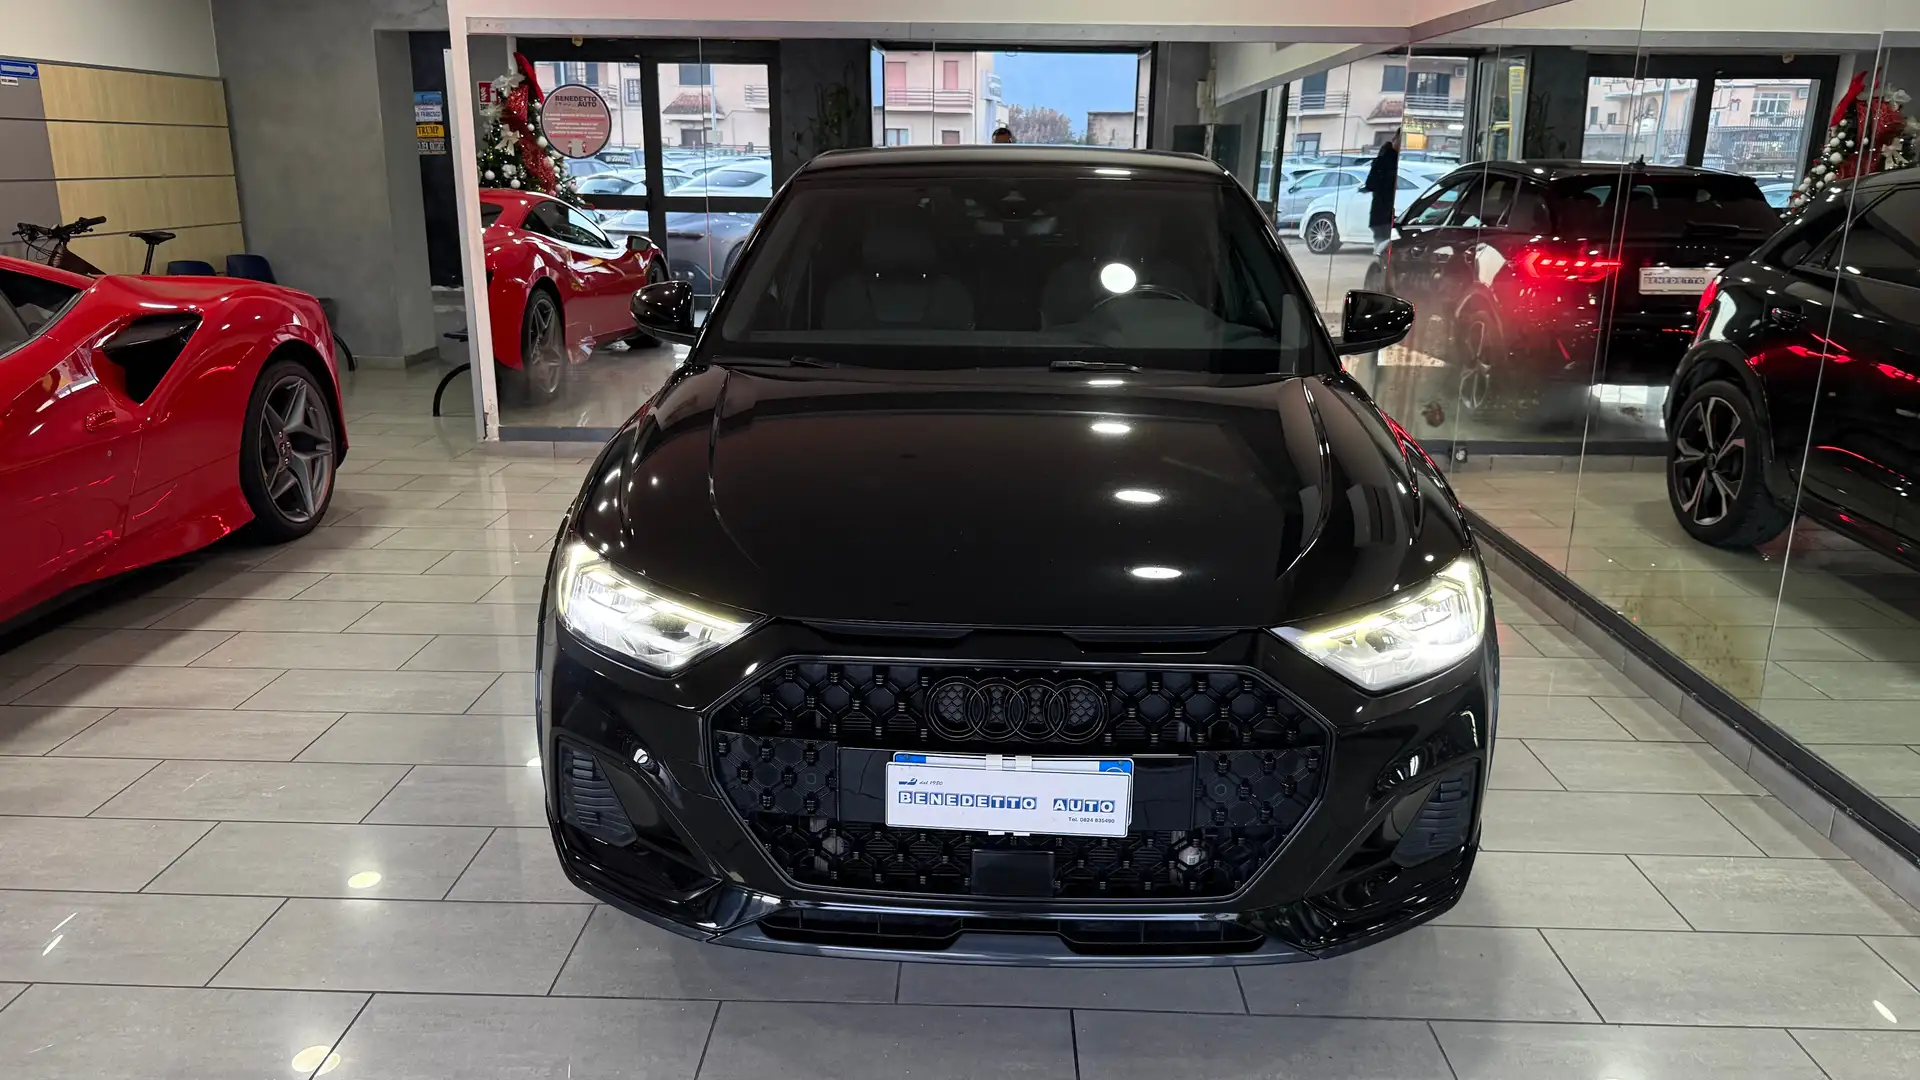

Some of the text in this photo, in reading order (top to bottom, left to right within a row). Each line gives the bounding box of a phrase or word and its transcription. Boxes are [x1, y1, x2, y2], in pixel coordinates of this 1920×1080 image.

[417, 126, 439, 135] TRUMP
[898, 791, 1115, 813] BENEDETTO AUTO
